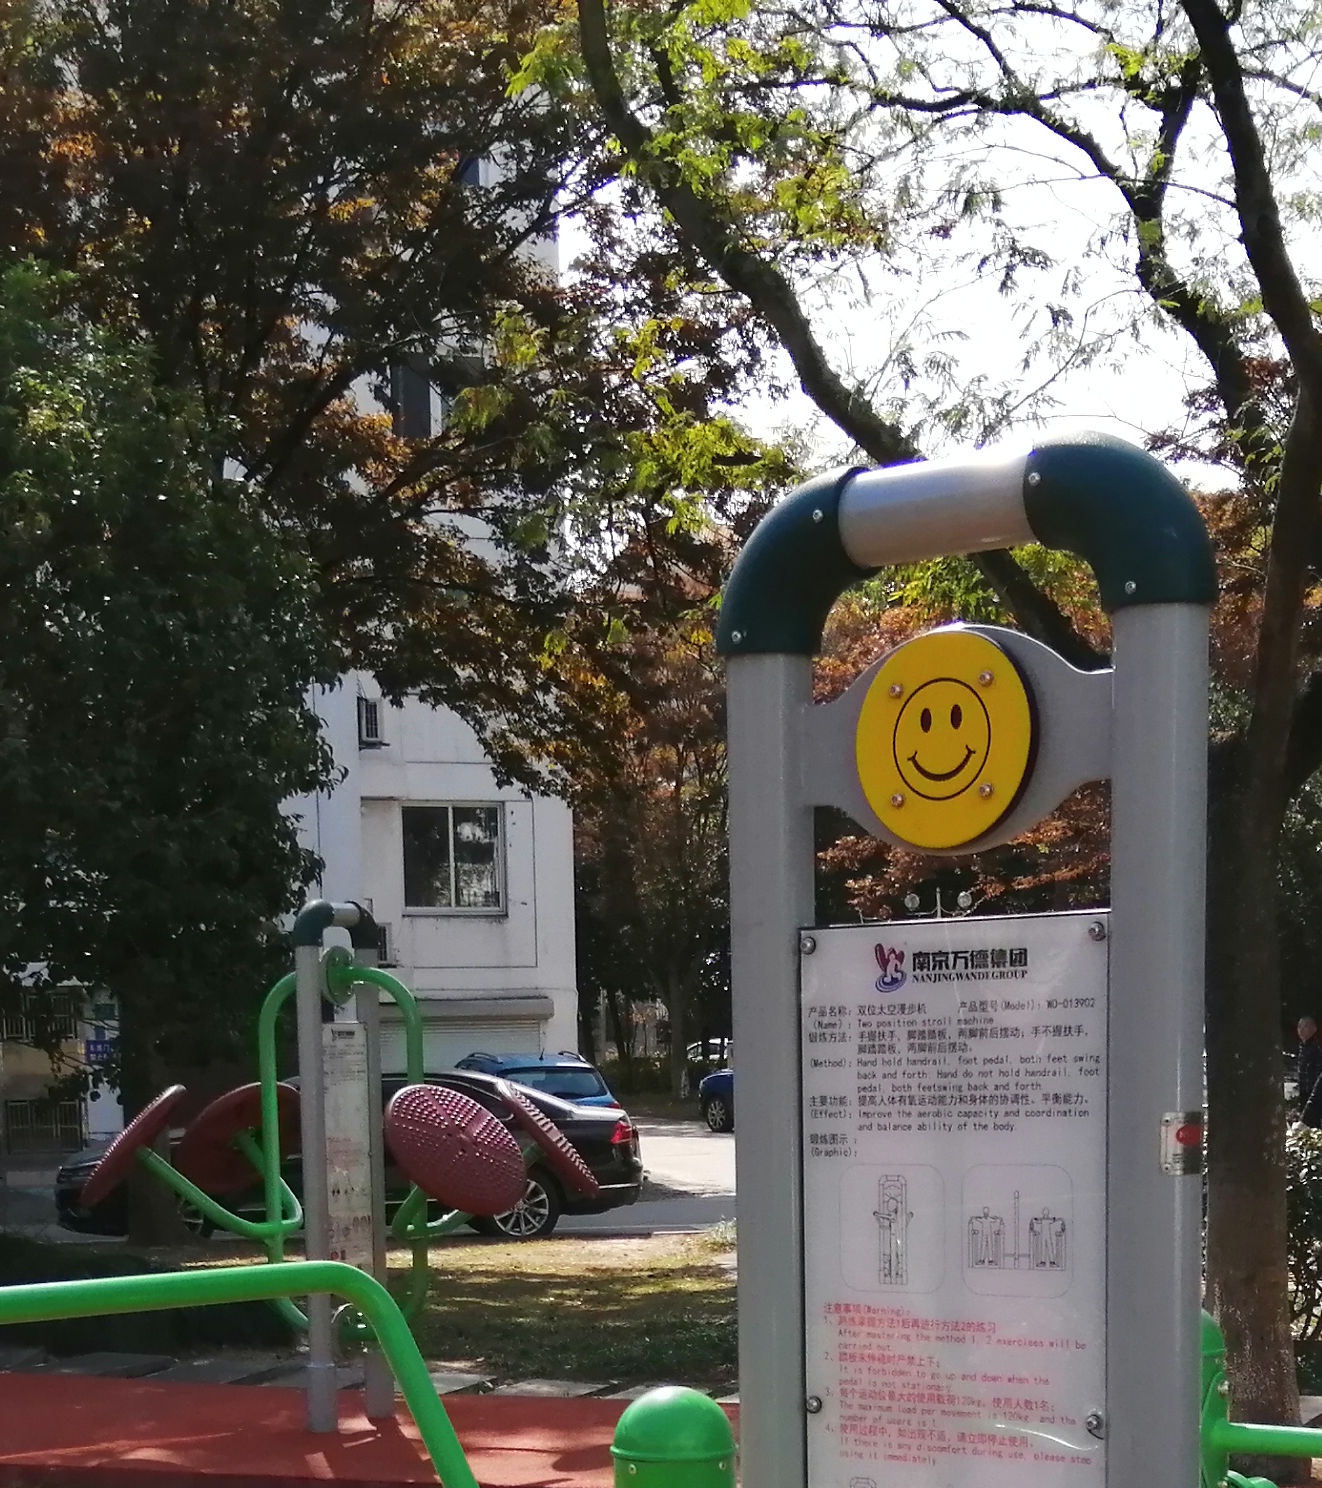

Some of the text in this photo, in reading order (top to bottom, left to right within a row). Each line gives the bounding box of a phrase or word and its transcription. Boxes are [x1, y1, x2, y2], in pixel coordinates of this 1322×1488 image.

[912, 948, 1028, 972] 南京万德集团
[857, 1003, 927, 1016] 双位太空漫步机
[857, 1018, 873, 1029] Two
[876, 1018, 917, 1030] position
[922, 1016, 952, 1027] stroll
[857, 1057, 878, 1067] Hand
[881, 1056, 903, 1066] hold
[958, 1055, 978, 1065] foot
[1019, 1054, 1042, 1064] both
[1046, 1053, 1068, 1064] feet
[1073, 1053, 1101, 1065] swing
[857, 1070, 877, 1080] back
[881, 1069, 898, 1079] and
[937, 1068, 958, 1079] Hand
[962, 1068, 974, 1079] do
[978, 1069, 993, 1078] not
[998, 1068, 1020, 1078] hold
[1078, 1066, 1099, 1077] foot
[891, 1083, 913, 1092] both
[967, 1081, 989, 1092] back
[994, 1081, 1010, 1091] and
[858, 1109, 893, 1119] Improve
[897, 1109, 913, 1118] the
[917, 1109, 953, 1119] aerobic
[957, 1108, 999, 1119] capacity
[1004, 1108, 1020, 1118] and
[1024, 1107, 1090, 1118] coordination
[857, 1122, 873, 1132] and
[877, 1122, 913, 1132] balance
[917, 1121, 953, 1132] ability
[957, 1121, 968, 1131] of
[973, 1121, 989, 1131] the
[838, 1328, 861, 1338] After
[916, 1333, 931, 1342] the
[935, 1334, 966, 1344] method
[996, 1338, 1044, 1348] exercises
[1049, 1338, 1070, 1348] will
[1075, 1340, 1086, 1350] be
[853, 1365, 863, 1375] is
[867, 1366, 912, 1377] forbidden
[916, 1370, 926, 1379] to
[930, 1372, 941, 1381] go
[945, 1372, 957, 1382] up
[961, 1372, 977, 1382] and
[981, 1373, 1003, 1383] down
[1007, 1374, 1029, 1384] when
[1034, 1376, 1050, 1386] the
[838, 1378, 862, 1387] pedal
[868, 1380, 878, 1388] is
[881, 1380, 896, 1389] not
[840, 1400, 854, 1410] The
[898, 1405, 917, 1415] load
[920, 1408, 936, 1416] per
[1039, 1415, 1055, 1424] and
[1061, 1415, 1076, 1425] the
[839, 1414, 867, 1422] number
[872, 1415, 882, 1424] of
[917, 1419, 927, 1428] is
[897, 1442, 912, 1452] any
[916, 1443, 967, 1455] discomfort
[971, 1447, 1004, 1458] during
[1033, 1452, 1066, 1463] please
[1070, 1456, 1092, 1465] stop
